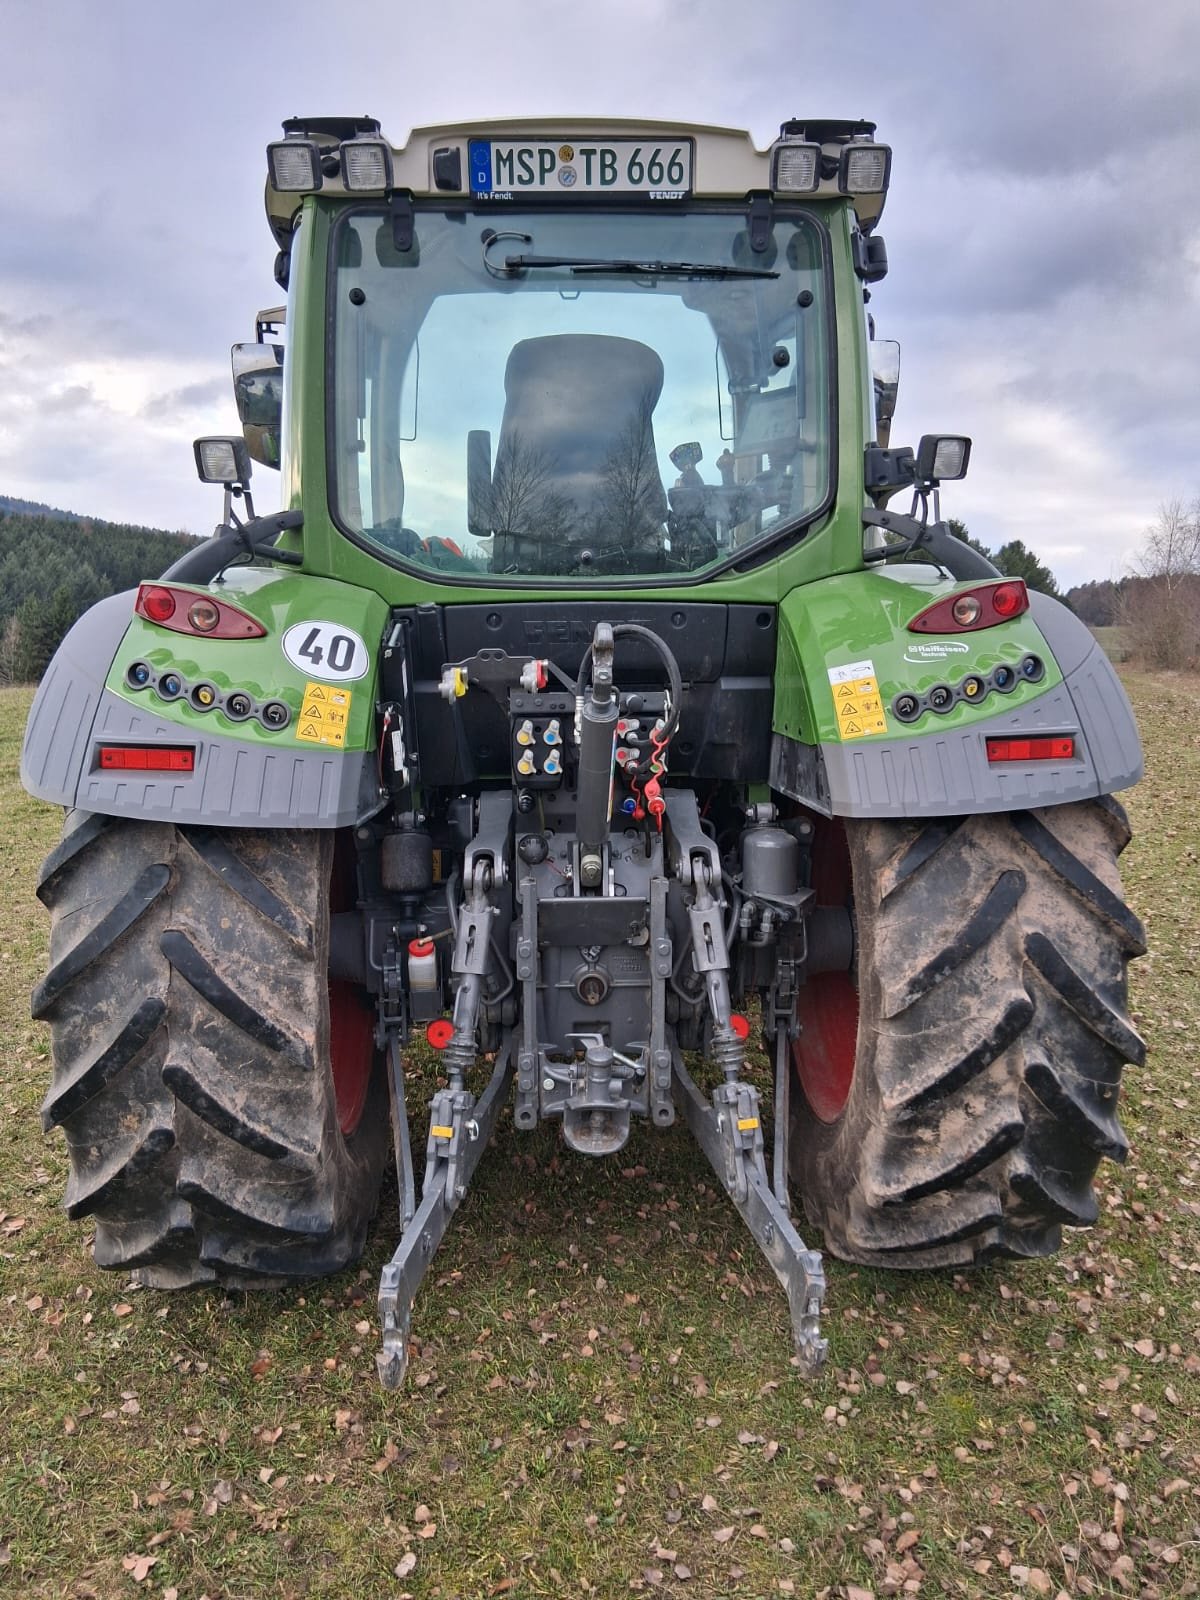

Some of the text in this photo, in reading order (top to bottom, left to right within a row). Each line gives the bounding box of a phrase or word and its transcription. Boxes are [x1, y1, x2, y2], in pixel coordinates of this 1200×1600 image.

[495, 148, 684, 186] MSP TB 666
[478, 172, 486, 183] D
[477, 192, 489, 200] It's
[649, 191, 686, 200] FENDT
[298, 627, 356, 672] 40
